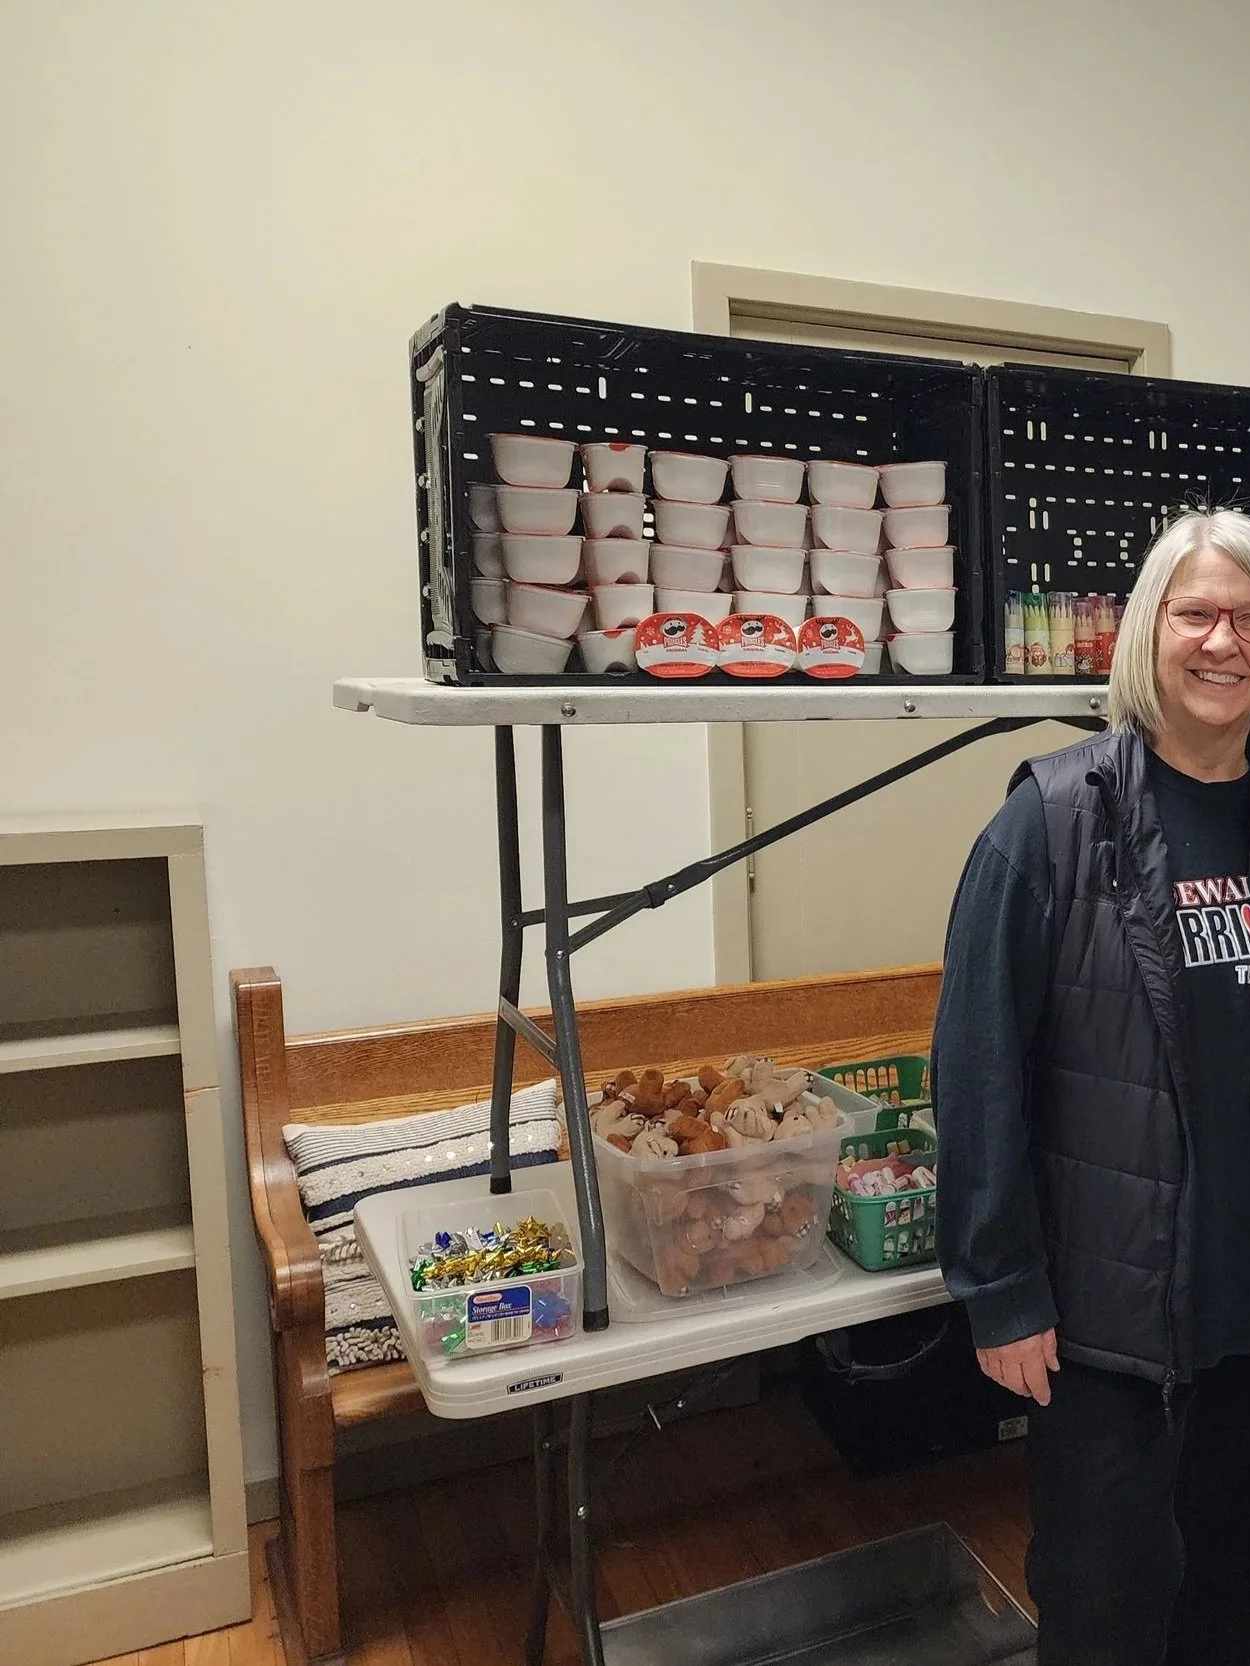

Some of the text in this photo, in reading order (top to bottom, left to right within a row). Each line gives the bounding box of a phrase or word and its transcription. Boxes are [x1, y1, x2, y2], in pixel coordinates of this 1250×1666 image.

[472, 1302, 512, 1314] Storage Box
[514, 1376, 556, 1391] LIFETIME
